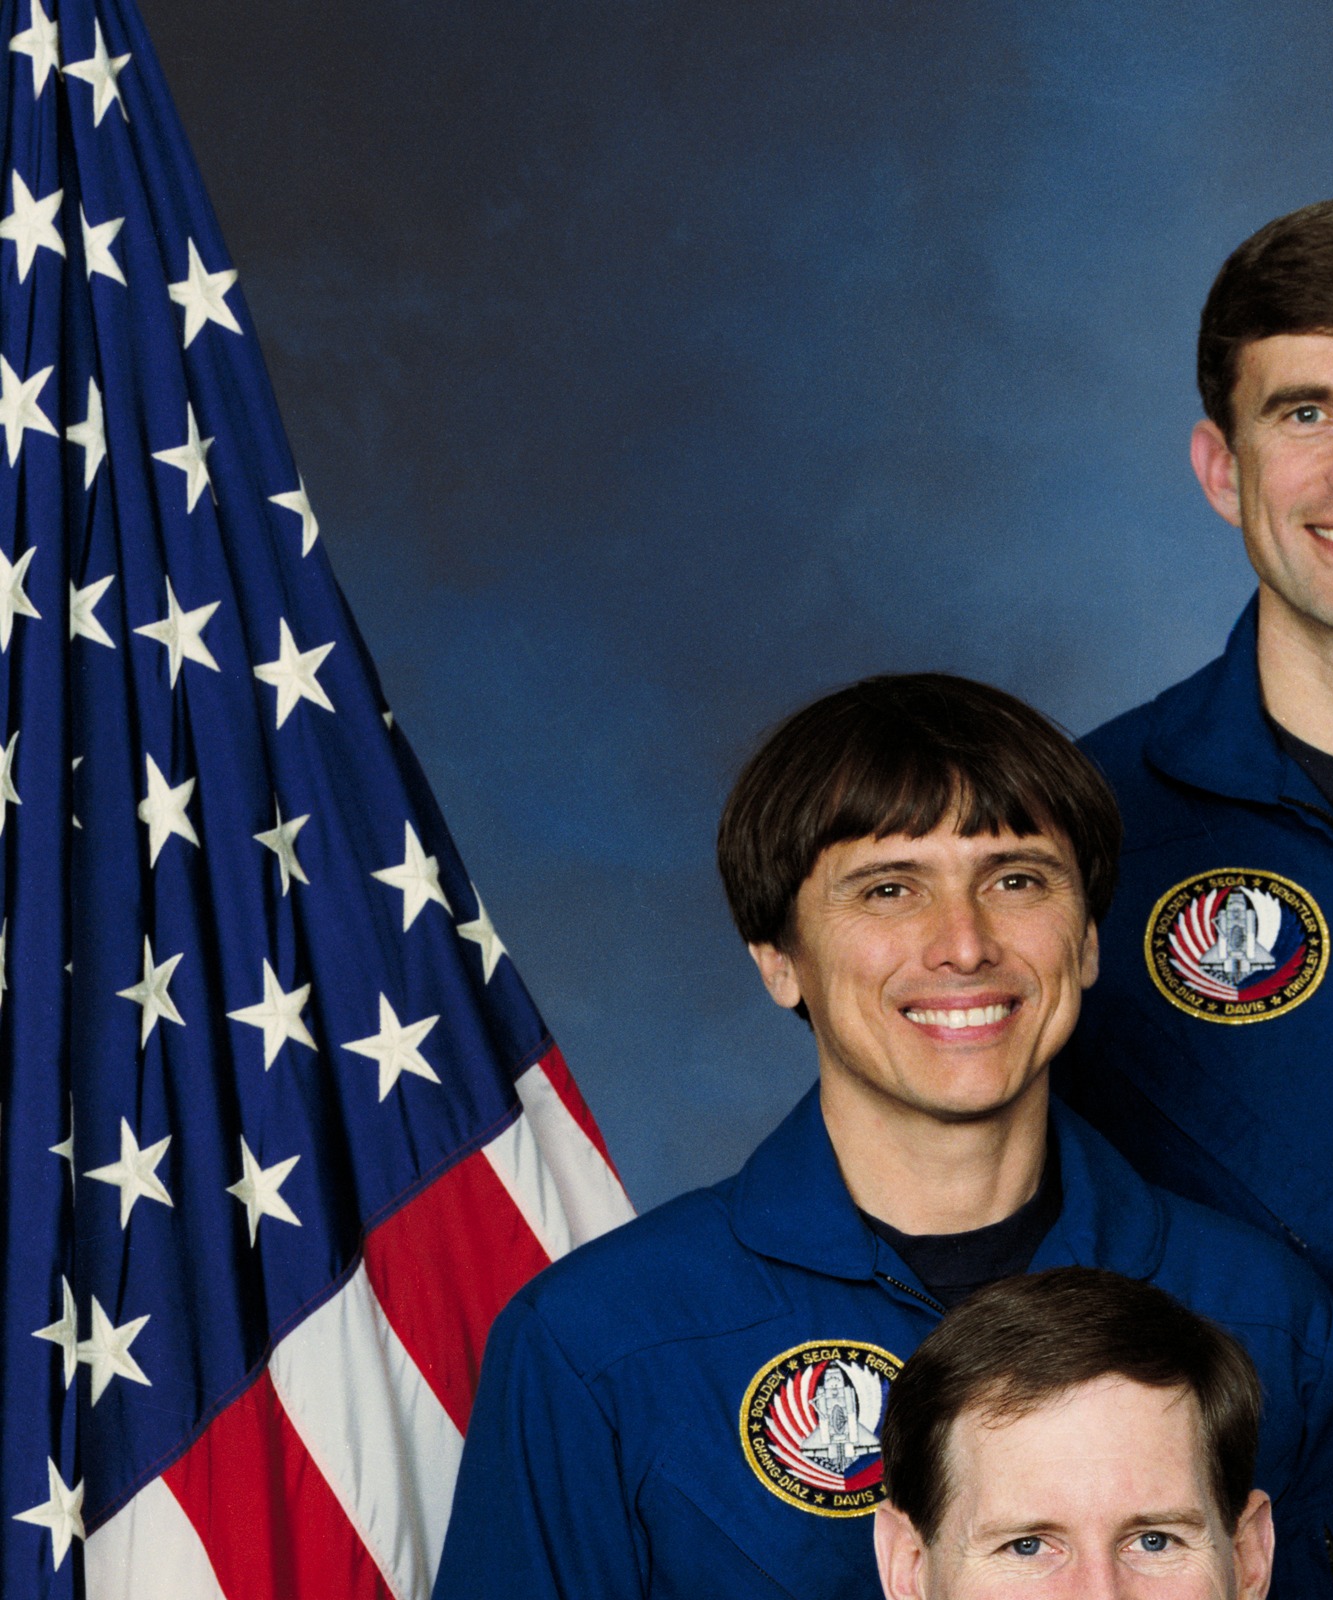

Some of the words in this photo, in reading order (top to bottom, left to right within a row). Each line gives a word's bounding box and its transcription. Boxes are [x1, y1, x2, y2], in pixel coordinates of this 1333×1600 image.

[1157, 892, 1190, 934] BOLDEN
[1208, 875, 1246, 888] SEGA
[1268, 882, 1317, 933] REIGHTLER
[1224, 1001, 1266, 1015] DAVIS
[752, 1370, 786, 1418] BOLDEN
[802, 1348, 841, 1364] SEGA
[833, 1490, 874, 1507] DAVIS
